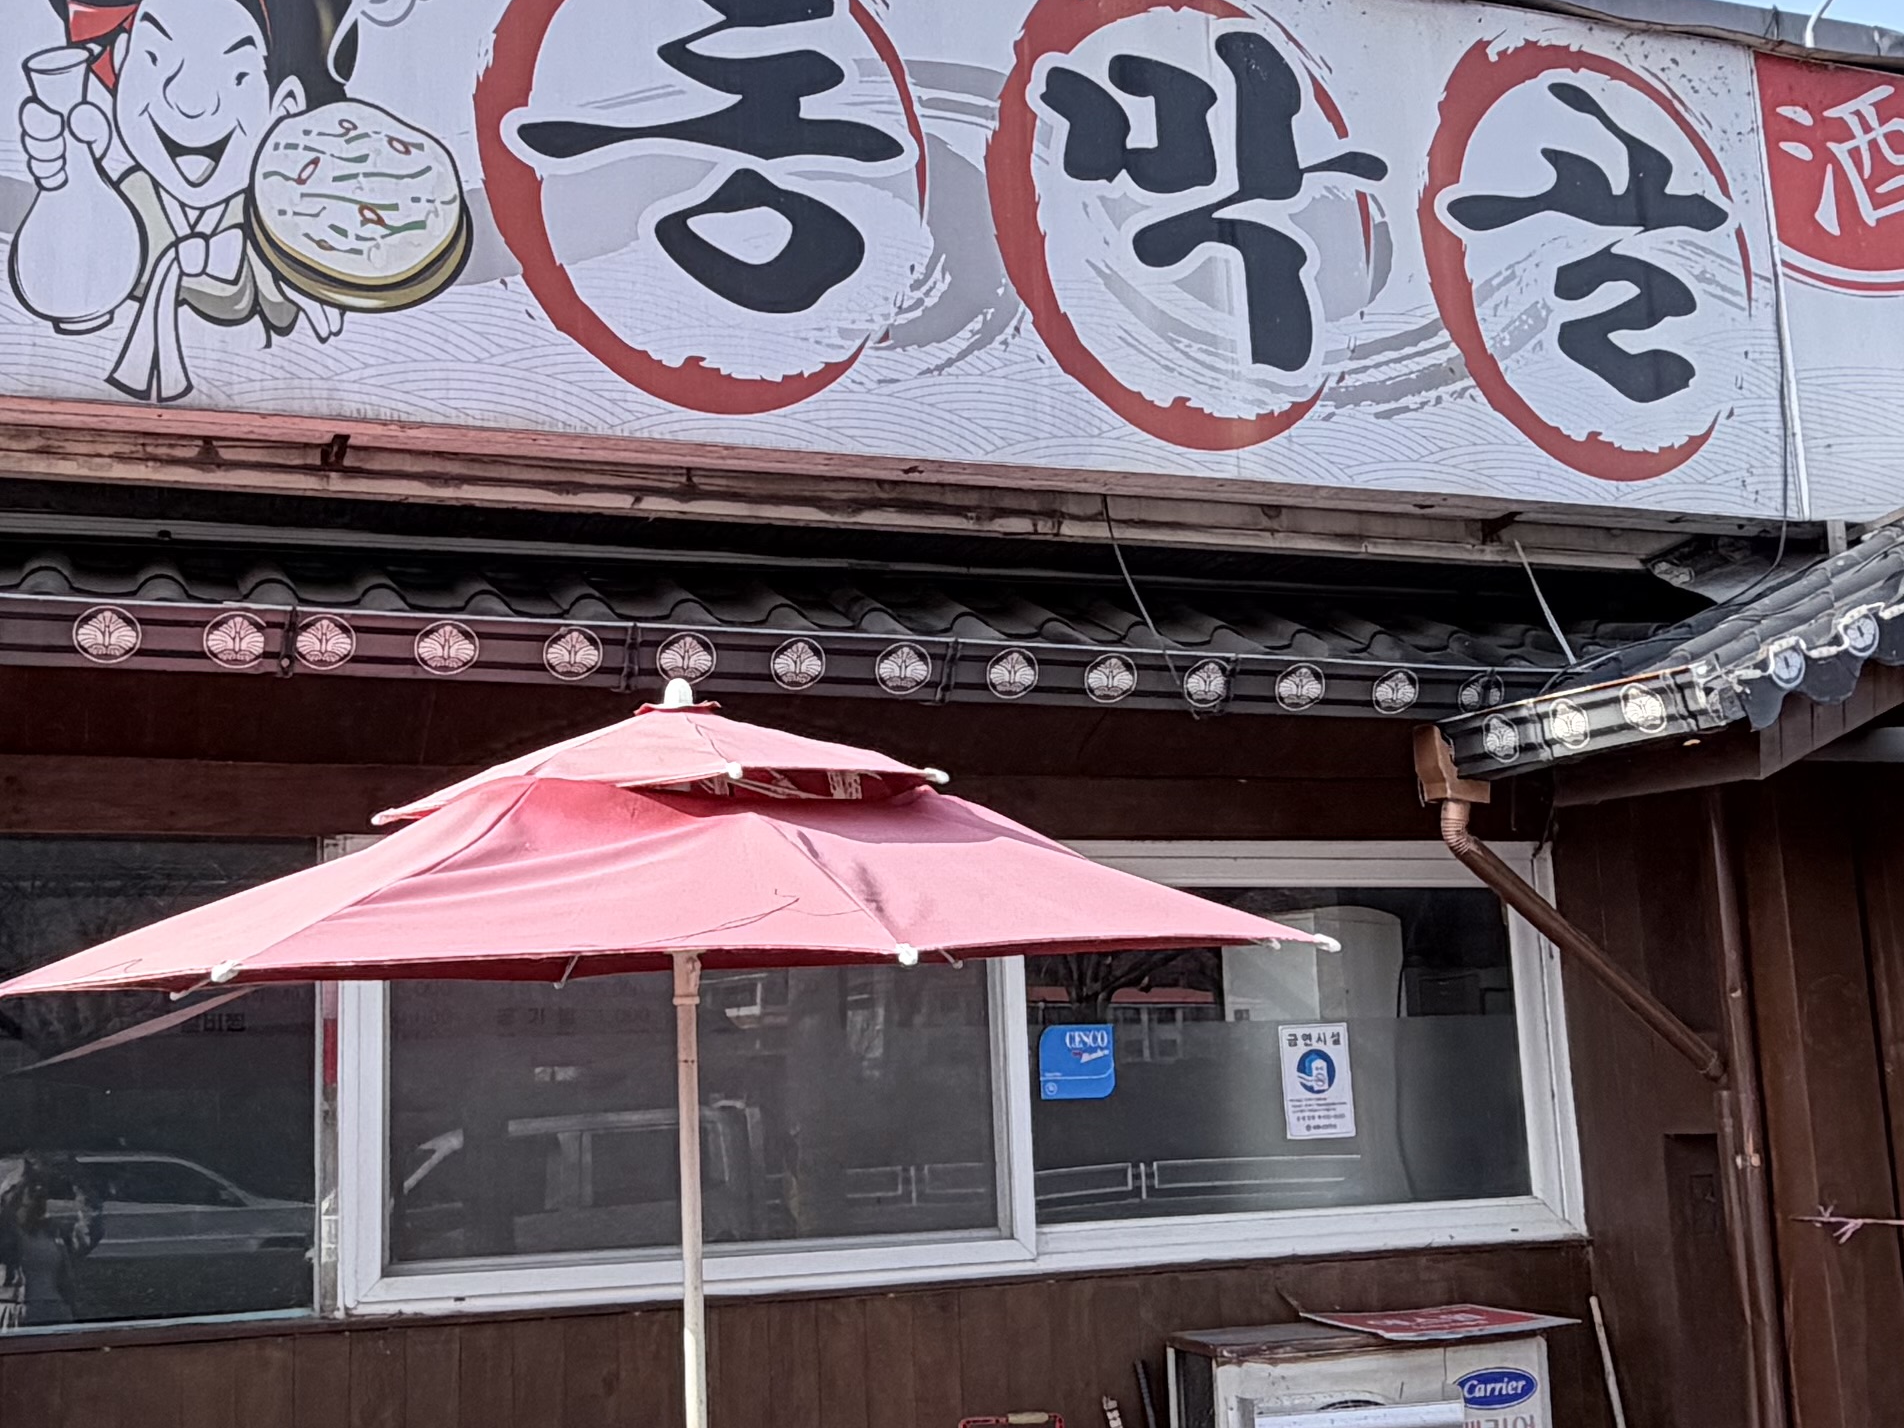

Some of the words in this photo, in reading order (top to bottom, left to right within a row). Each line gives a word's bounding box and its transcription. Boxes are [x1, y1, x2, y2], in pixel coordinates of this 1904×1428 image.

[1065, 1029, 1108, 1048] CESCO
[1287, 1031, 1342, 1048] 금연시설
[1463, 1378, 1527, 1399] Carrier
